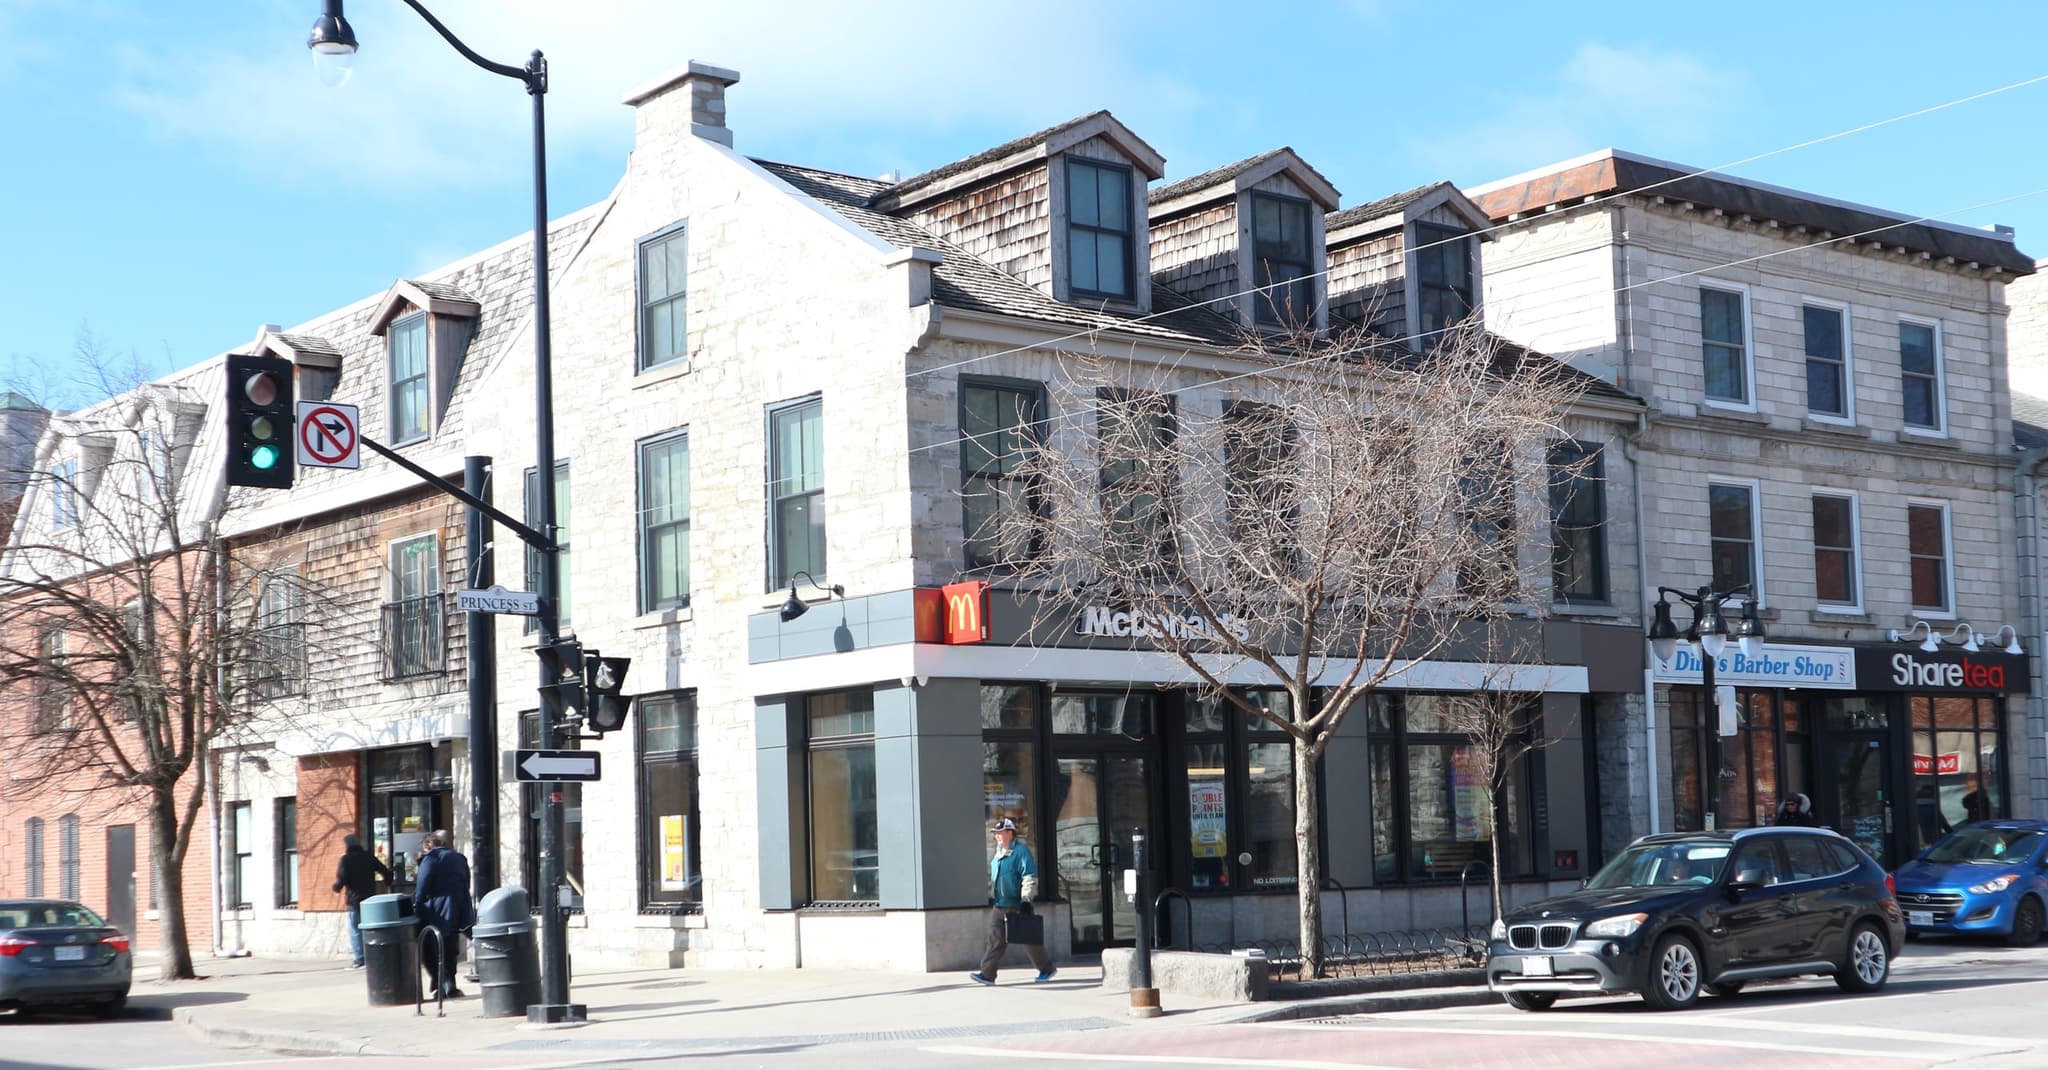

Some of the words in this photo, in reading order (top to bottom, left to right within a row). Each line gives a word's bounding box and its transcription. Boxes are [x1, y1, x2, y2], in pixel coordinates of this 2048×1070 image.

[461, 596, 520, 609] PRINCESS
[522, 602, 536, 611] ST.
[1675, 650, 1728, 673] Din's
[1733, 653, 1790, 675] Barber
[1794, 656, 1834, 681] Shop
[1892, 652, 2006, 689] Sharetea
[1192, 792, 1223, 803] DUBLE
[1192, 804, 1223, 813] PINTS
